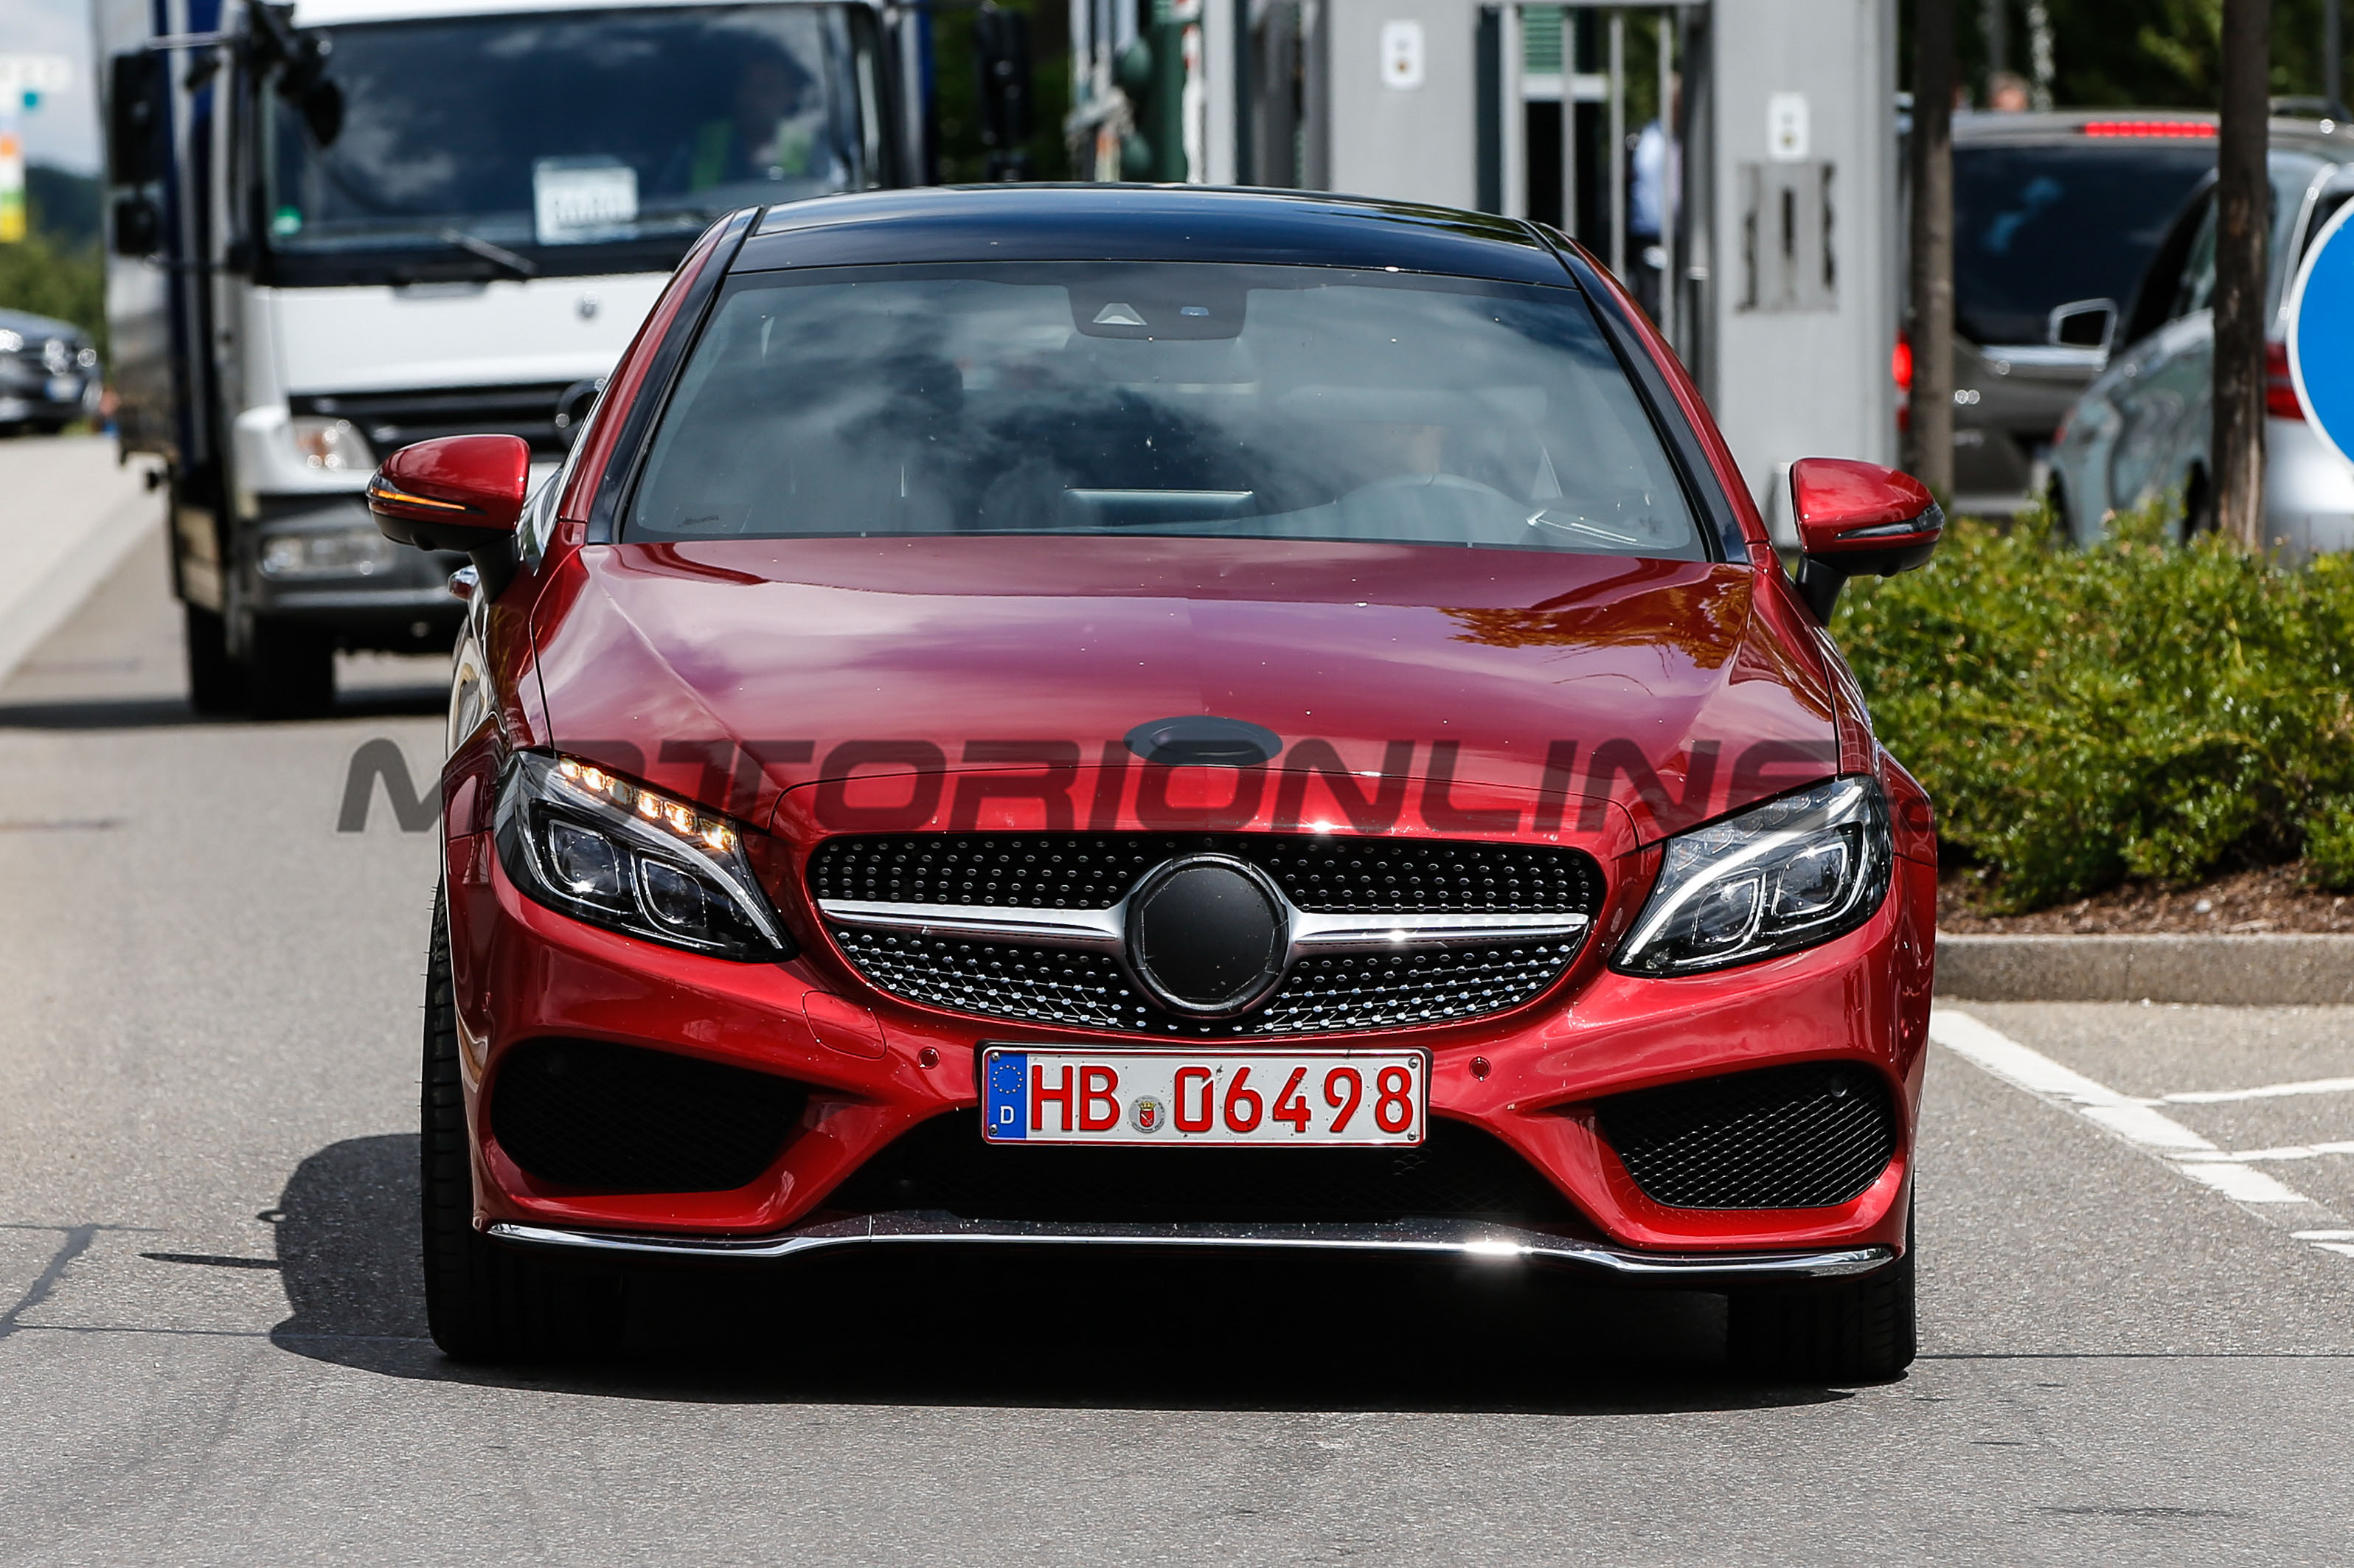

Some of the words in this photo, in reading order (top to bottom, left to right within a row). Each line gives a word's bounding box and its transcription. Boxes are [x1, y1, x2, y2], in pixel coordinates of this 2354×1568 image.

[1000, 1106, 1015, 1124] D
[1032, 1064, 1121, 1131] HB
[1174, 1065, 1414, 1134] 06498
